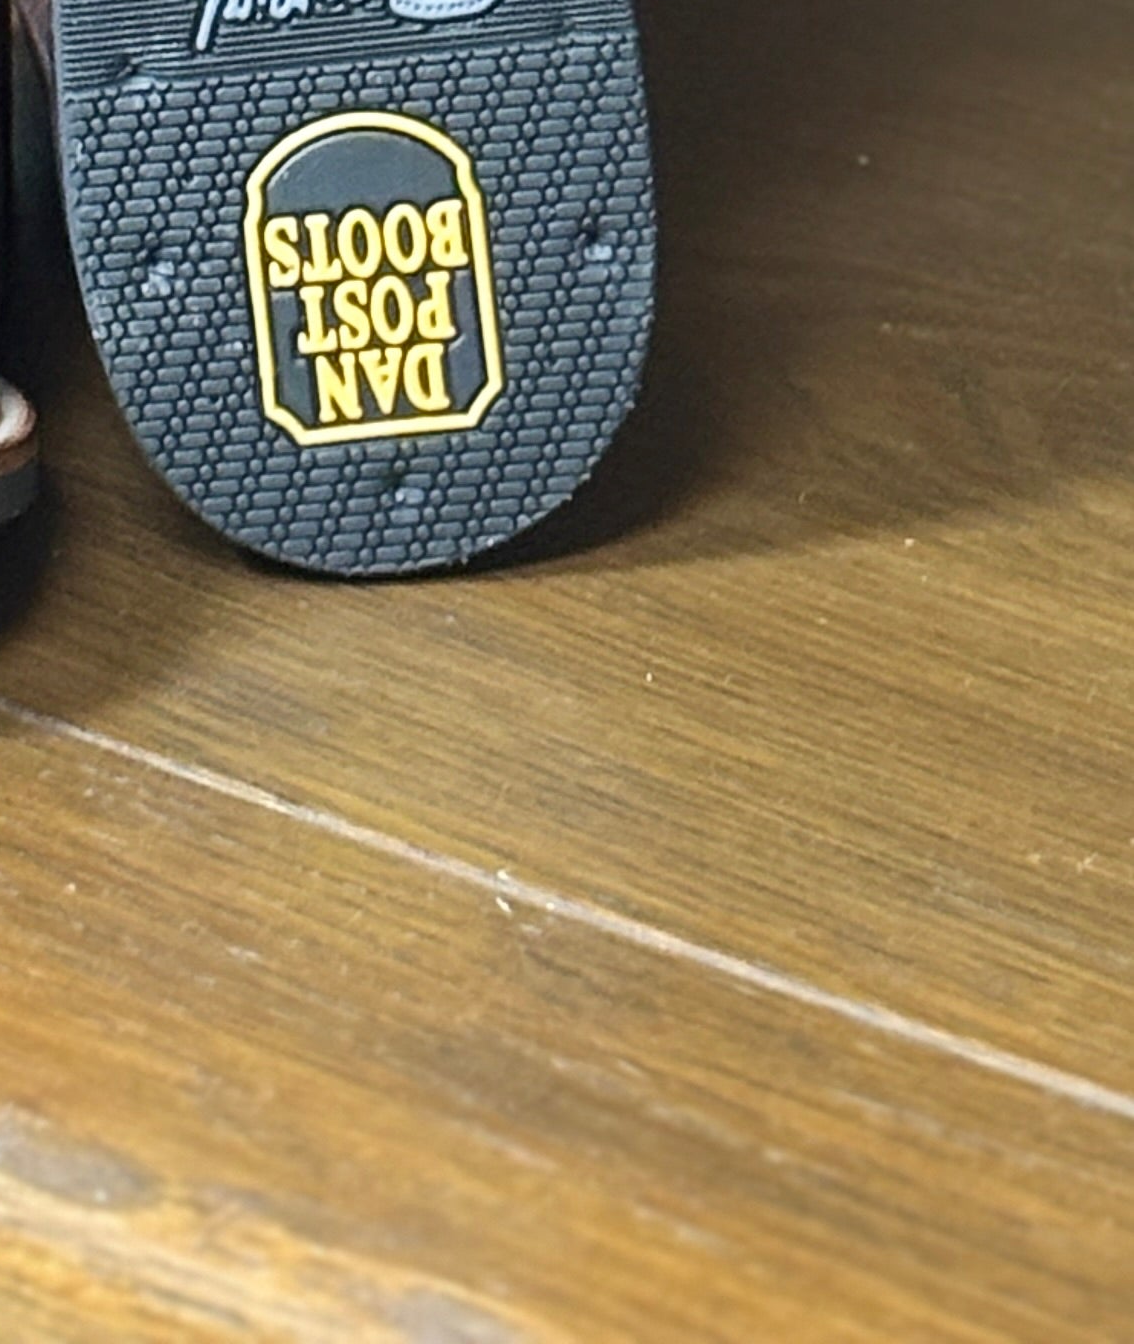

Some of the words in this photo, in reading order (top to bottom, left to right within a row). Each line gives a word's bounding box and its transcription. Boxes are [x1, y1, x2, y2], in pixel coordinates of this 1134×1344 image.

[263, 199, 468, 288] BOOTS
[298, 272, 456, 354] POST
[316, 343, 450, 423] DAN
